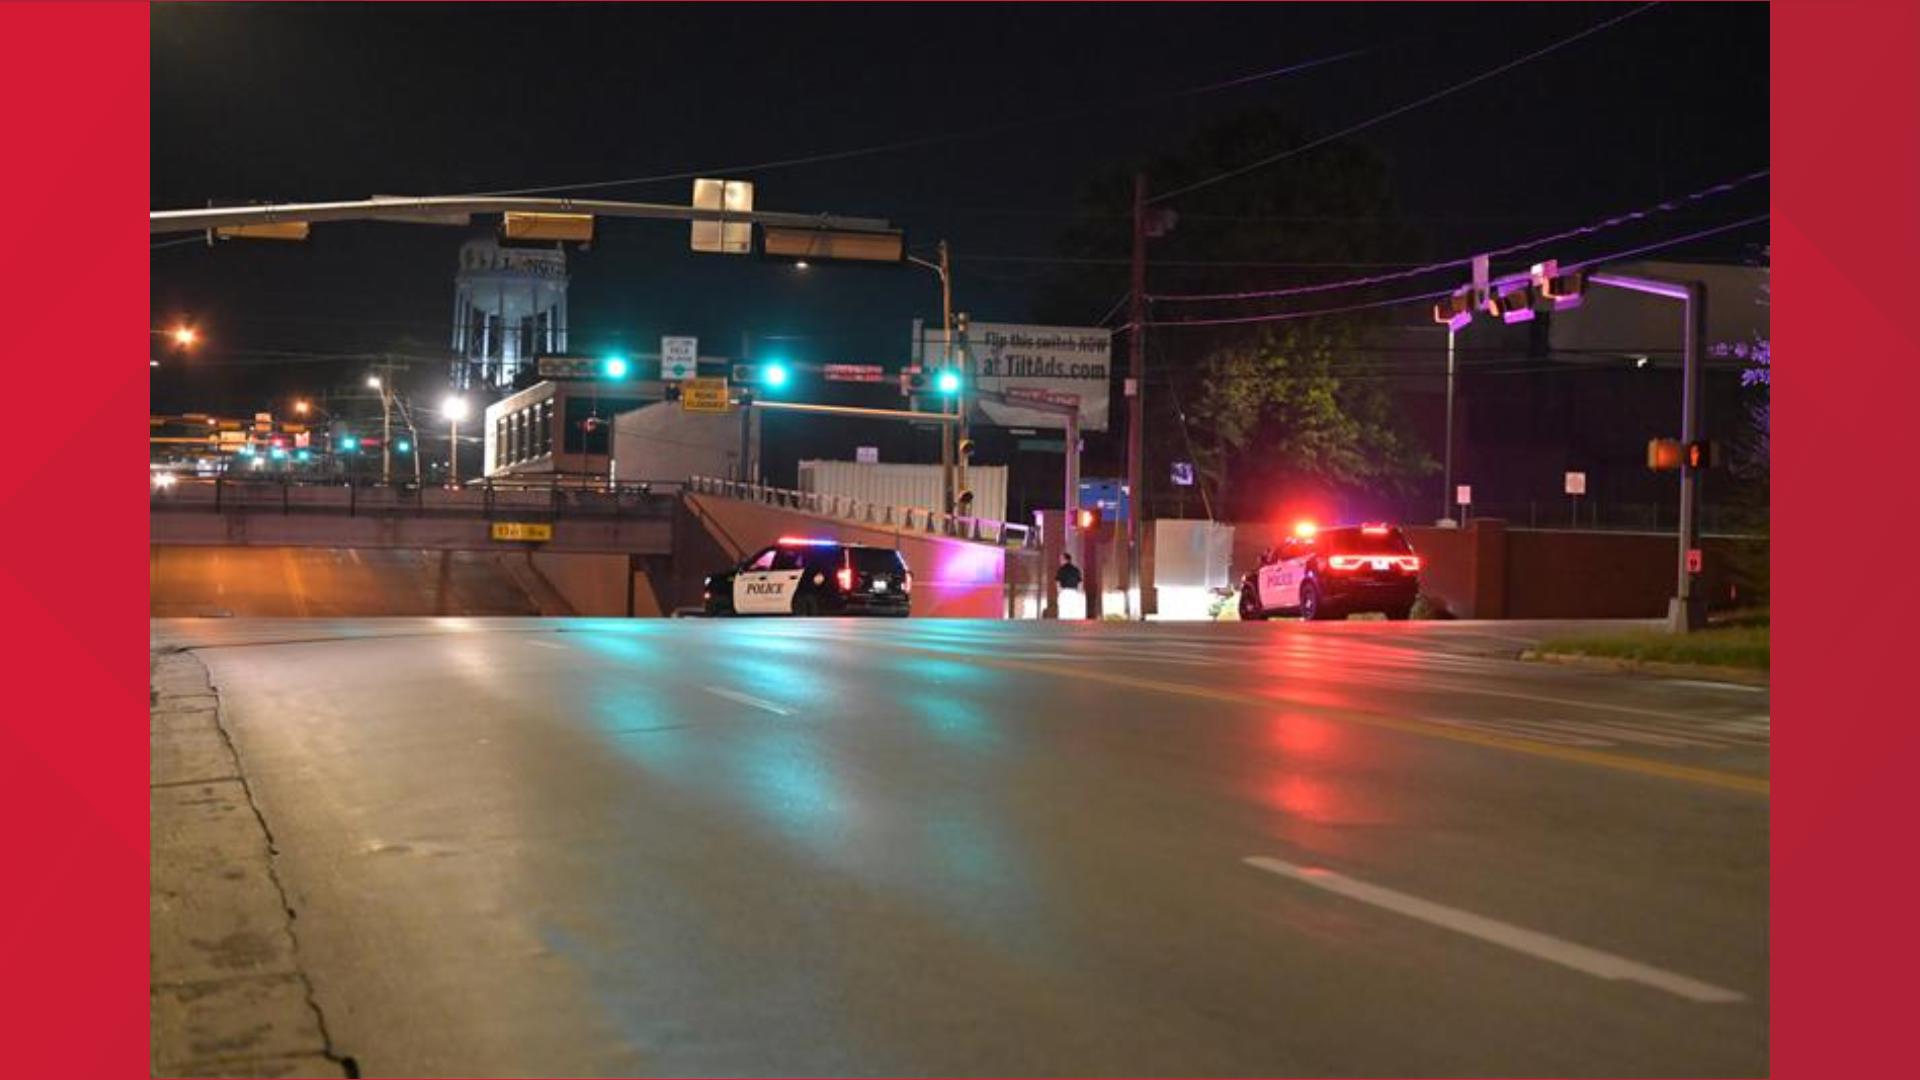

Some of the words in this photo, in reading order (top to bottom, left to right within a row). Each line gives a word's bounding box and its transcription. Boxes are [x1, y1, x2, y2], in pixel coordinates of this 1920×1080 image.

[985, 332, 1007, 347] Flip
[1010, 333, 1033, 345] this
[1036, 335, 1074, 348] switch
[983, 357, 1002, 376] at
[1006, 355, 1106, 378] TiltAds.com
[746, 583, 784, 595] POLICE
